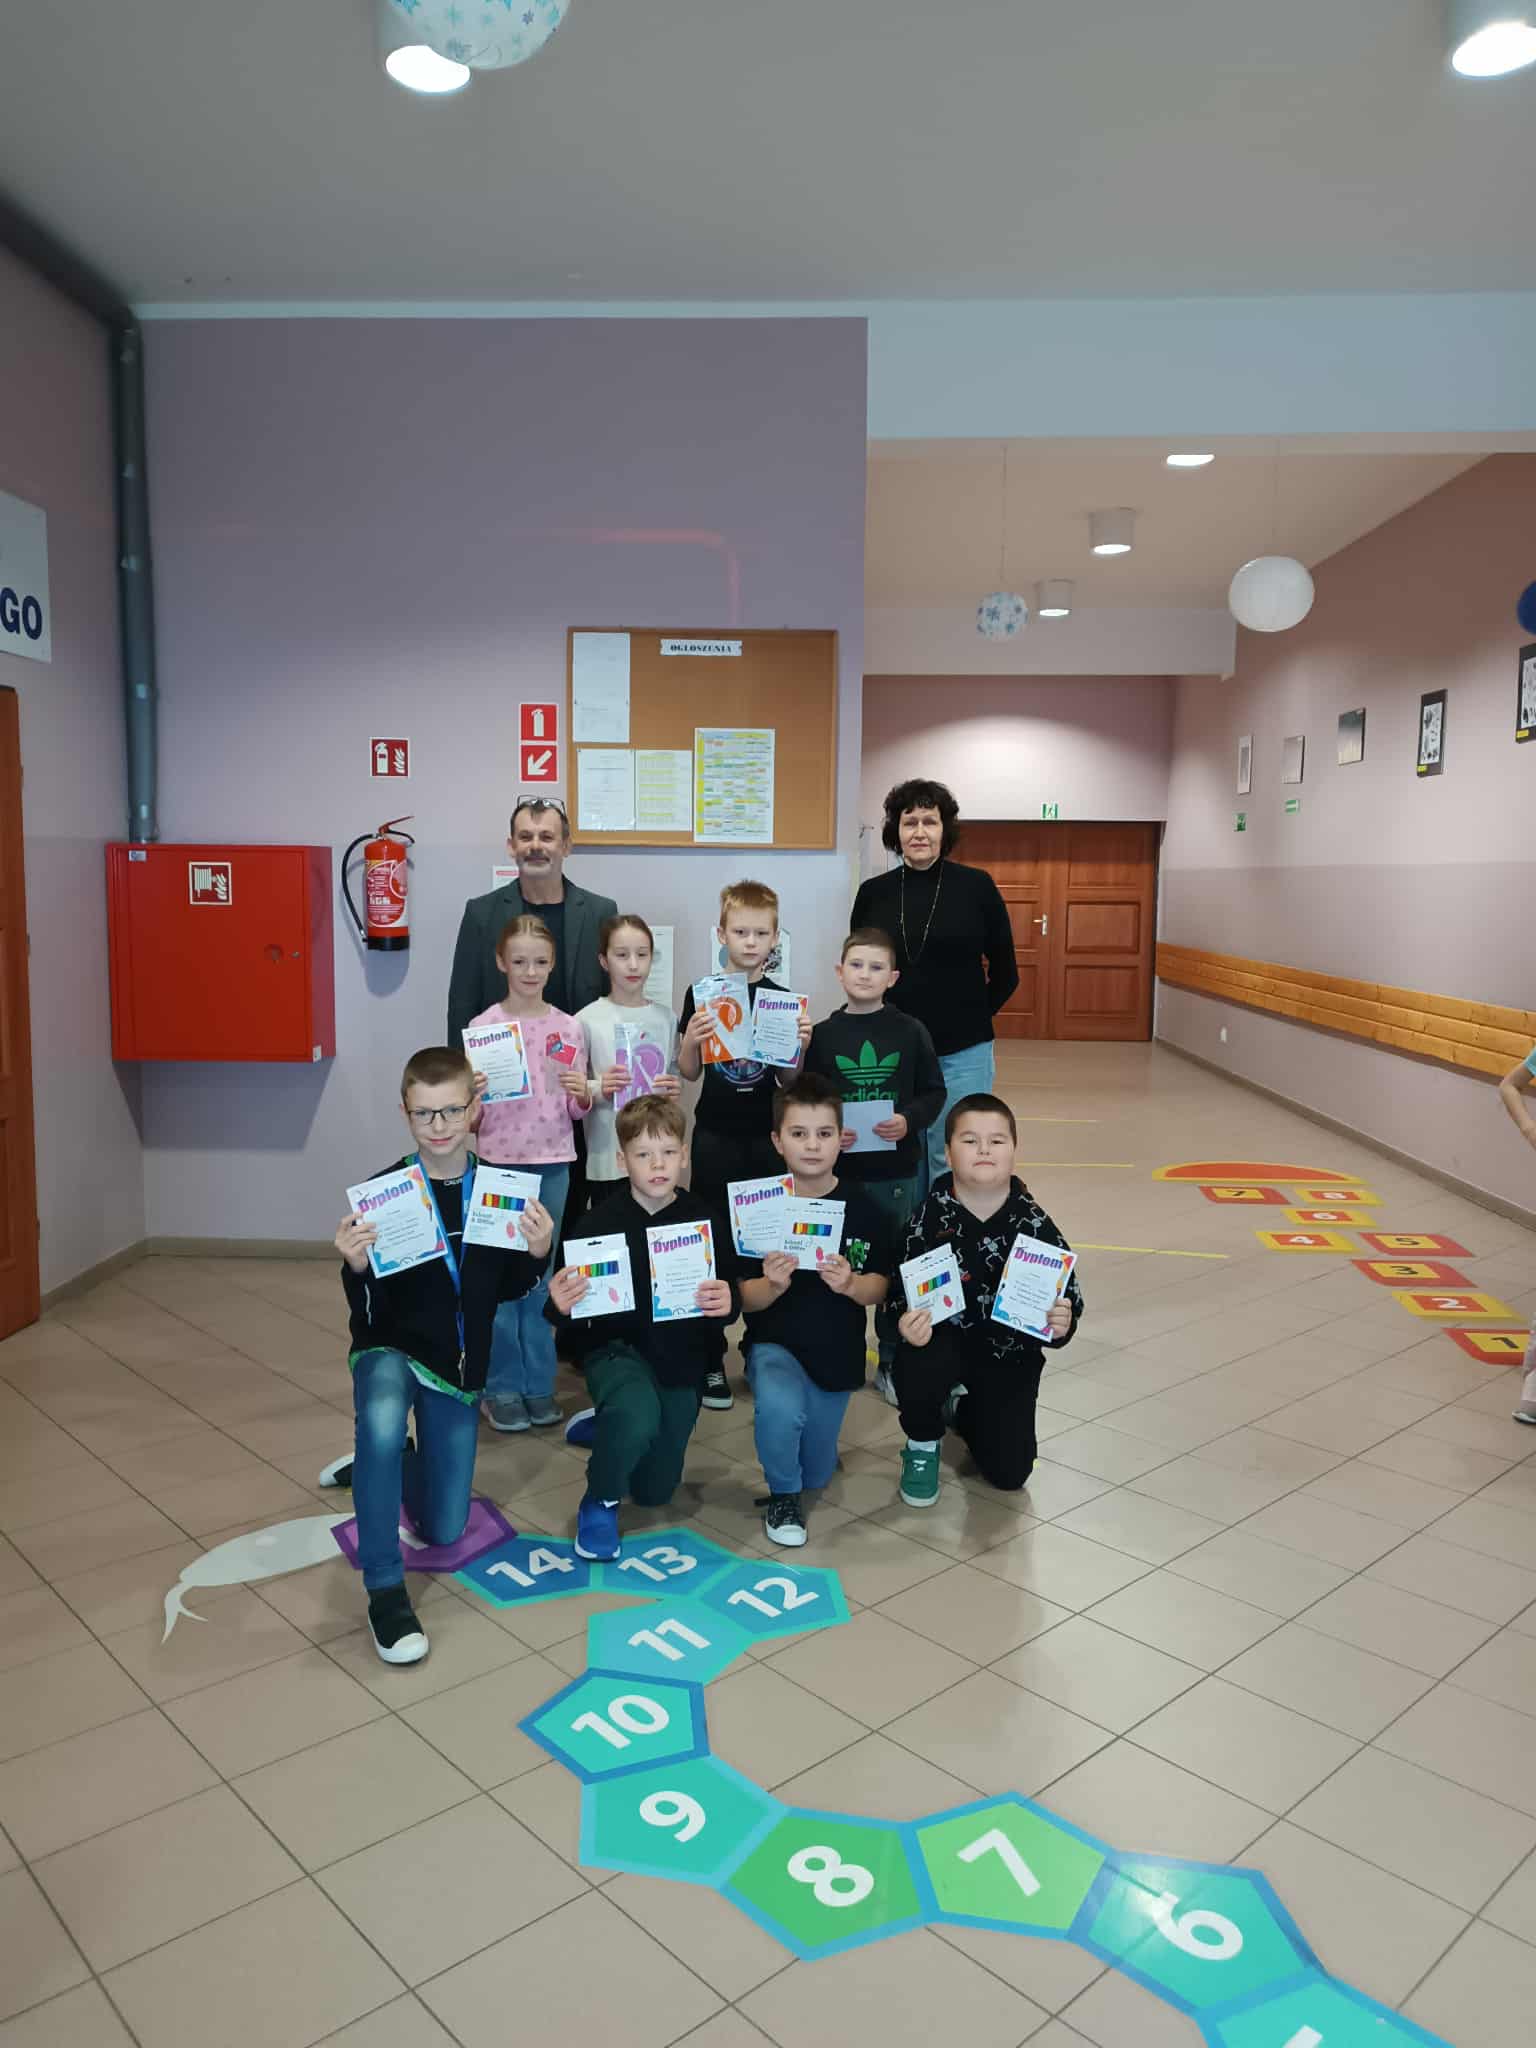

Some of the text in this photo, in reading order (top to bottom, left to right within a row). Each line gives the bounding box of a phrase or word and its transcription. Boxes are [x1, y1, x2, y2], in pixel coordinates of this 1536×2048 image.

[758, 998, 799, 1011] Dyplom
[467, 1030, 513, 1048] Dyplom
[358, 1179, 414, 1213] Dyplom
[734, 1186, 784, 1206] Dyplom
[1312, 1211, 1338, 1221] 6
[653, 1233, 703, 1254] Dyplom
[1289, 1235, 1315, 1245] 4
[1395, 1237, 1420, 1247] 5
[1014, 1246, 1063, 1270] Dyplom
[1389, 1264, 1419, 1276] 3
[1431, 1297, 1468, 1309] 2
[1491, 1336, 1520, 1349] 1
[485, 1547, 576, 1588] 14
[617, 1546, 698, 1582] 13
[727, 1576, 819, 1618] 12
[627, 1618, 712, 1661] 11
[570, 1694, 670, 1749] 10
[639, 1790, 706, 1843] 9
[956, 1828, 1041, 1897] 7
[787, 1845, 874, 1908] 8
[1152, 1891, 1243, 1960] 6
